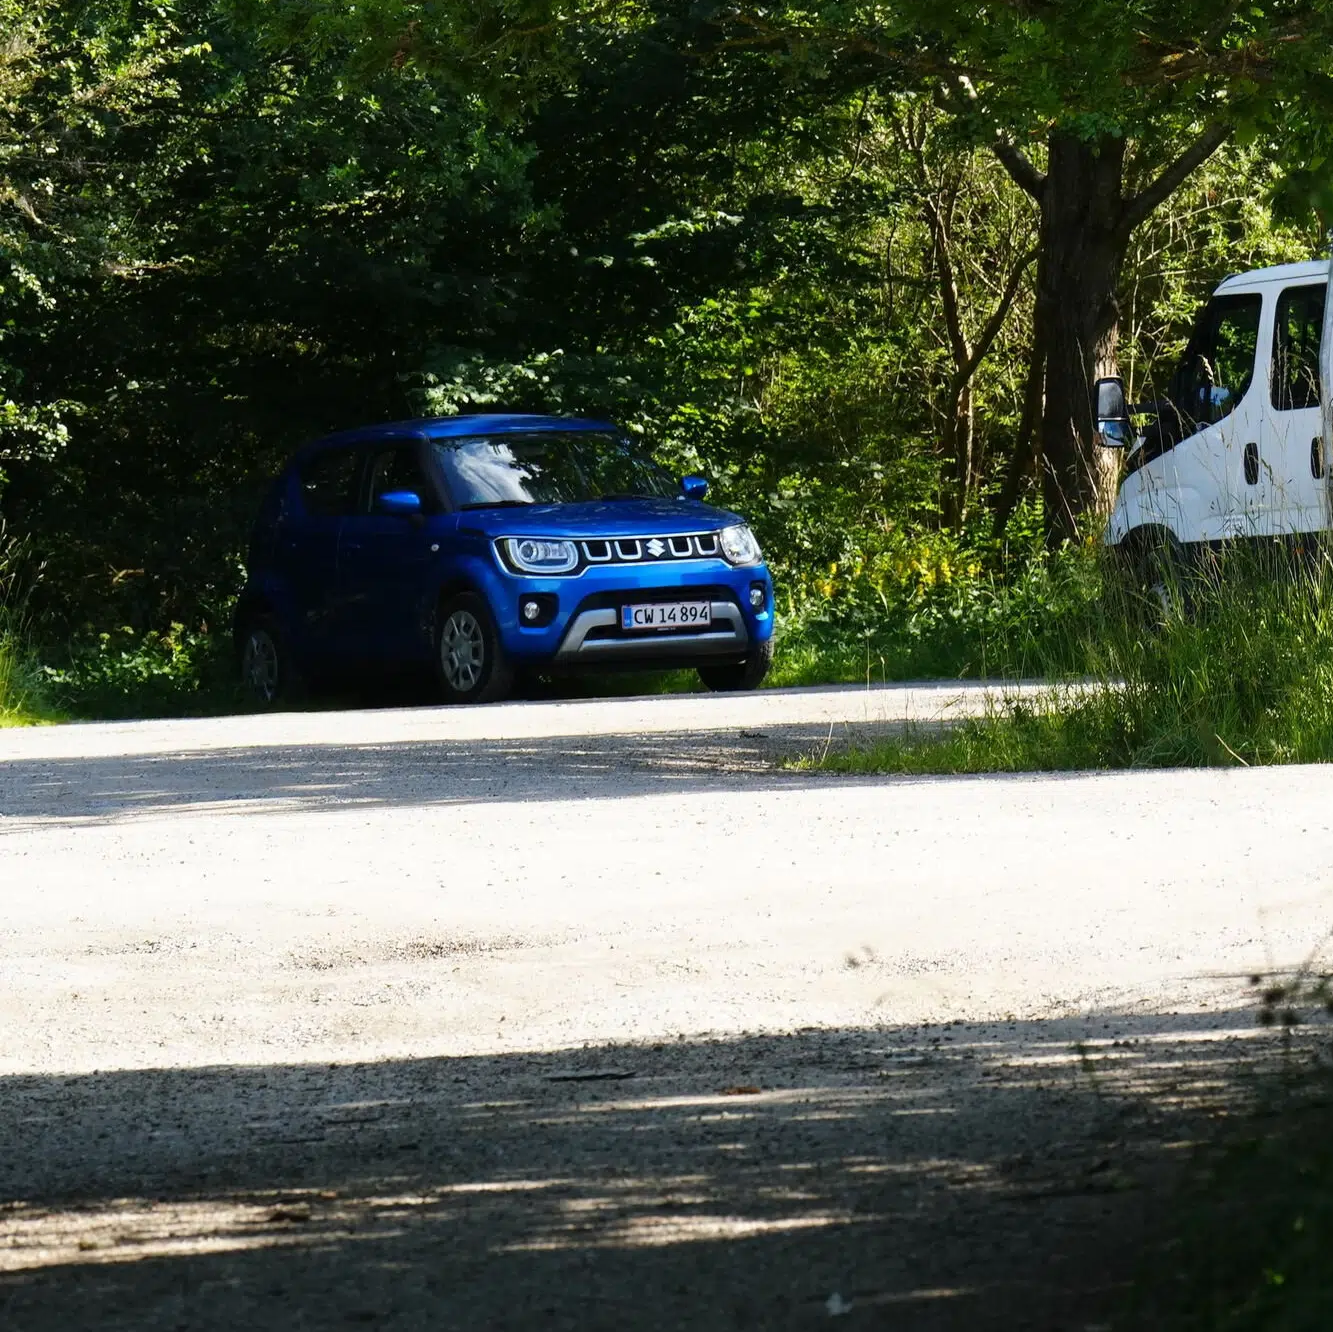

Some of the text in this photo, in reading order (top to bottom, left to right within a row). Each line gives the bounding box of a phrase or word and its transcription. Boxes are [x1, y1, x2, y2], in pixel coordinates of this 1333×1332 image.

[634, 609, 654, 624] CW
[659, 608, 676, 622] 14
[680, 606, 708, 622] 894
